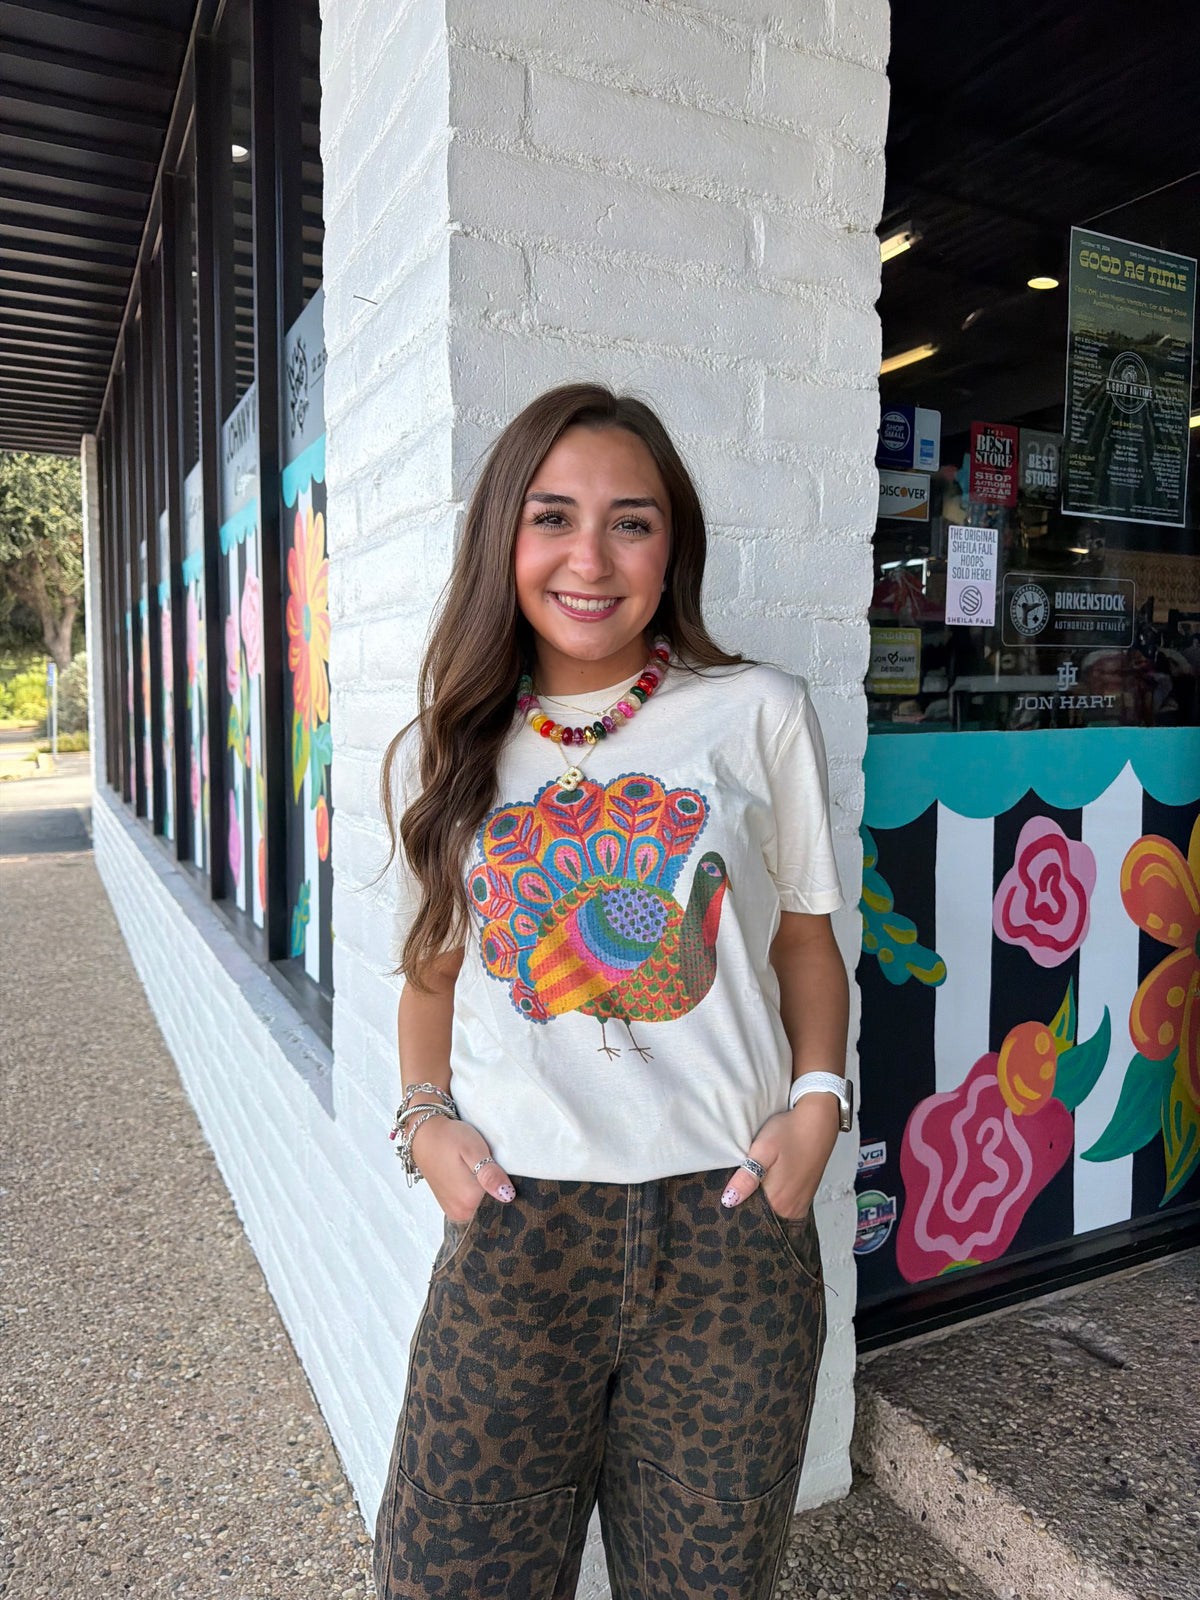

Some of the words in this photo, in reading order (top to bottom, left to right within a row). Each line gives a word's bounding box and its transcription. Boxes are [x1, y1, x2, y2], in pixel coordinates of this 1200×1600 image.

[1079, 249, 1121, 275] GOOD
[1124, 260, 1145, 281] AG
[1148, 266, 1187, 292] TIME
[885, 423, 905, 432] SHOP
[884, 431, 905, 440] SMALL
[976, 434, 1013, 455] BEST
[975, 451, 1013, 468] STORE
[1028, 454, 1056, 471] BEST
[974, 472, 1012, 482] SHOP
[1025, 470, 1057, 488] STORE
[879, 485, 926, 500] DISCOVER
[974, 486, 1012, 496] TEXAS
[950, 527, 963, 540] THE
[964, 528, 996, 543] ORIGINAL
[952, 541, 977, 555] SHEILA
[978, 543, 993, 555] FAJL
[960, 554, 984, 568] HOOPS
[952, 567, 970, 580] SOLD
[971, 568, 992, 581] HERE!
[1055, 591, 1125, 611] BIRKENSTOCK
[1054, 620, 1094, 631] AUTHORIZED
[1096, 621, 1126, 632] RETAILER
[1014, 696, 1054, 711] JON
[1059, 695, 1116, 710] HART
